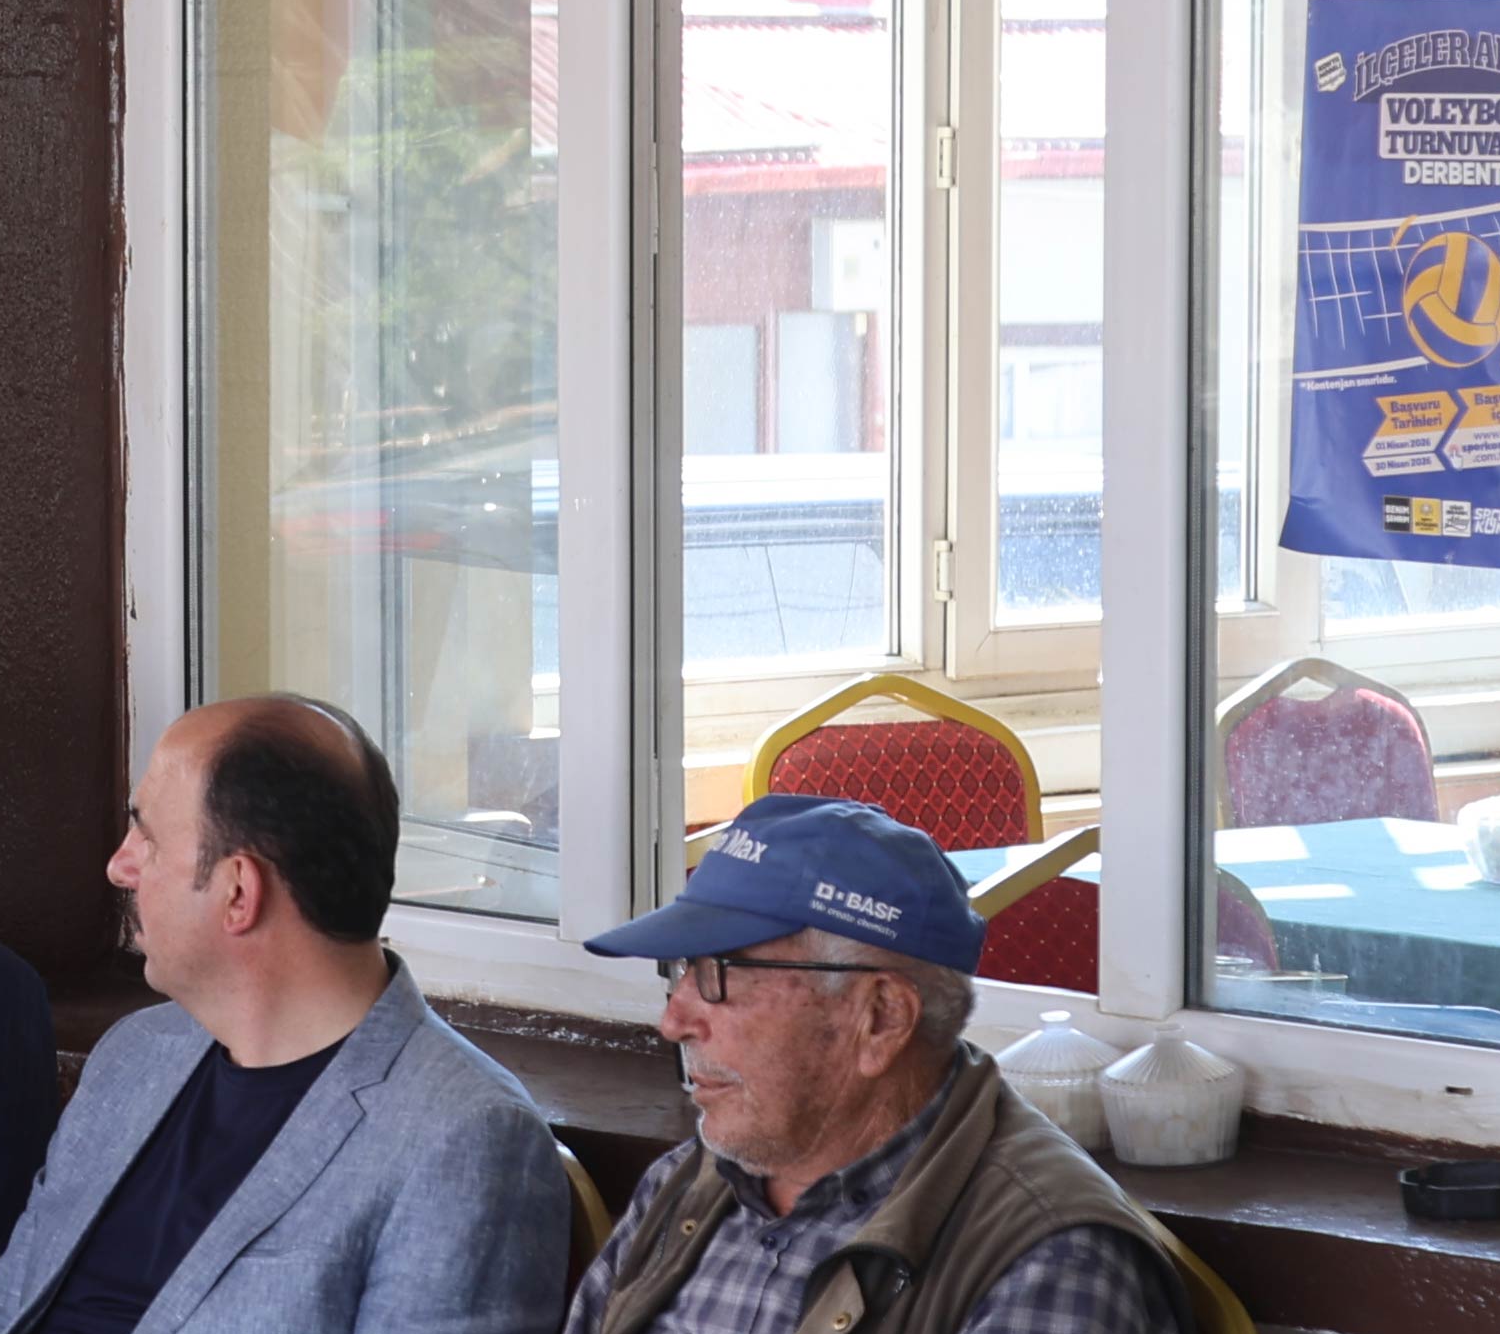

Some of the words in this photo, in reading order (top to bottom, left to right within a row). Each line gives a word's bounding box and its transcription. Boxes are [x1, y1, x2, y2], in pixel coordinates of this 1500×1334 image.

[1353, 29, 1471, 101] İLÇELER
[1390, 400, 1440, 415] Başvuru
[1391, 412, 1442, 429] Tarihleri
[721, 828, 768, 864] Max
[846, 892, 902, 922] BASF
